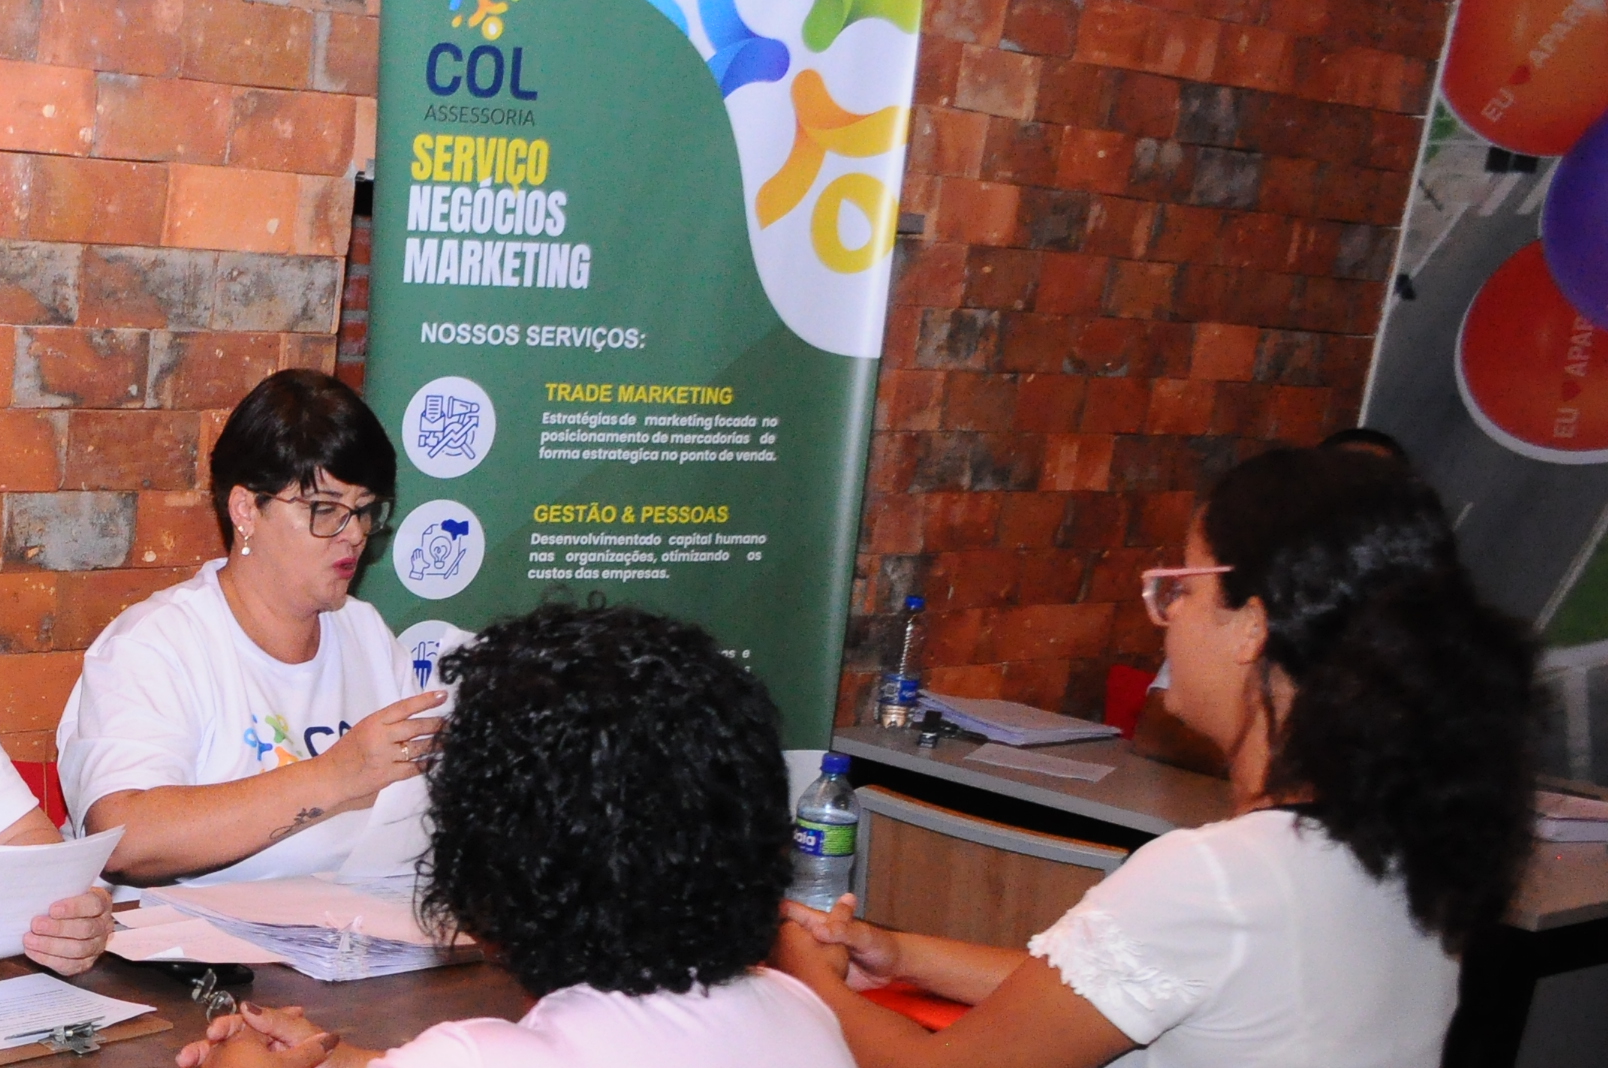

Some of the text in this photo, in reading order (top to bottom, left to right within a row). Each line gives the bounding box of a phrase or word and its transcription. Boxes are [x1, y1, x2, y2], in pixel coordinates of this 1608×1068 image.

[426, 42, 538, 101] COL
[424, 104, 535, 126] ASSESSORIA
[1480, 87, 1515, 123] EU
[411, 134, 550, 195] SERVIÇO
[407, 178, 567, 236] NEGÓCIOS
[403, 238, 591, 288] MARKETING
[420, 321, 647, 352] NOSSOS SERVIÇOS:
[545, 383, 734, 405] TRADE MARKETING
[619, 413, 637, 426] de
[644, 413, 712, 430] marketing
[714, 413, 757, 427] focada
[761, 417, 778, 427] no
[1553, 407, 1580, 438] EU
[540, 429, 776, 445] posicionamento de mercadorias de
[539, 446, 580, 459] forma
[661, 451, 678, 461] no
[679, 449, 717, 464] ponto
[718, 449, 734, 461] de
[736, 449, 777, 461] venda.
[533, 502, 730, 524] GESTÃO & PESSOAS
[668, 532, 712, 548] capital
[714, 532, 767, 544] humano
[529, 551, 555, 562] nas
[661, 549, 730, 562] otimizando
[746, 551, 762, 561] os
[527, 566, 670, 583] custos das empresas.
